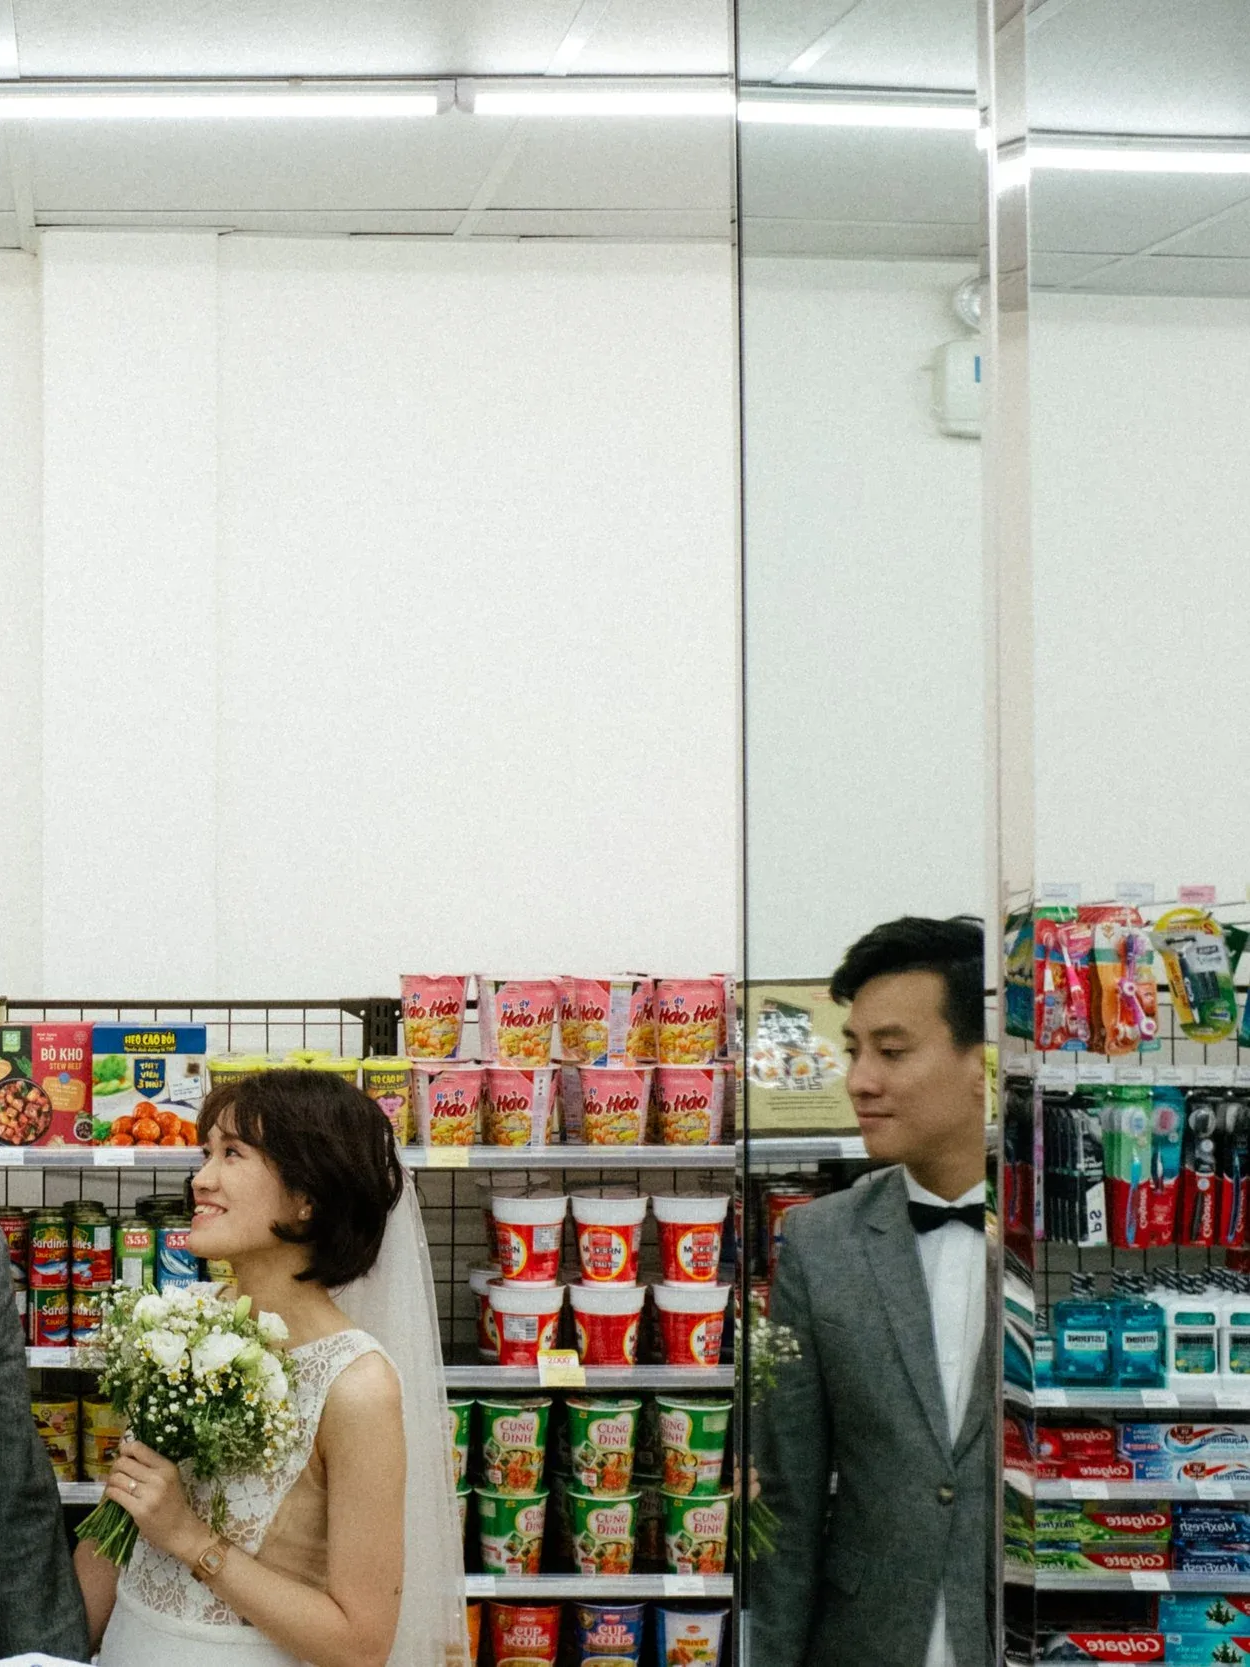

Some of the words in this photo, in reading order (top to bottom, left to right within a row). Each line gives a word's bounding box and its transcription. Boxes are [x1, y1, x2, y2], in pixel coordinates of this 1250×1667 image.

[500, 1007, 535, 1028] Hảo
[659, 1005, 690, 1025] Hảo
[40, 1045, 57, 1061] BÒ
[59, 1048, 83, 1061] KHO
[433, 1097, 468, 1117] Hảo
[496, 1091, 529, 1113] Hảo
[606, 1091, 639, 1113] Hảo
[674, 1090, 708, 1112] Hảo
[126, 1234, 148, 1245] 555
[501, 1420, 534, 1432] CUNG
[597, 1423, 629, 1434] CUNG
[595, 1512, 628, 1523] CUNG
[692, 1512, 724, 1523] CUNG
[513, 1625, 542, 1637] CUP
[597, 1625, 627, 1637] CUP
[503, 1634, 550, 1646] NOODLES
[587, 1633, 635, 1645] NOODLES
